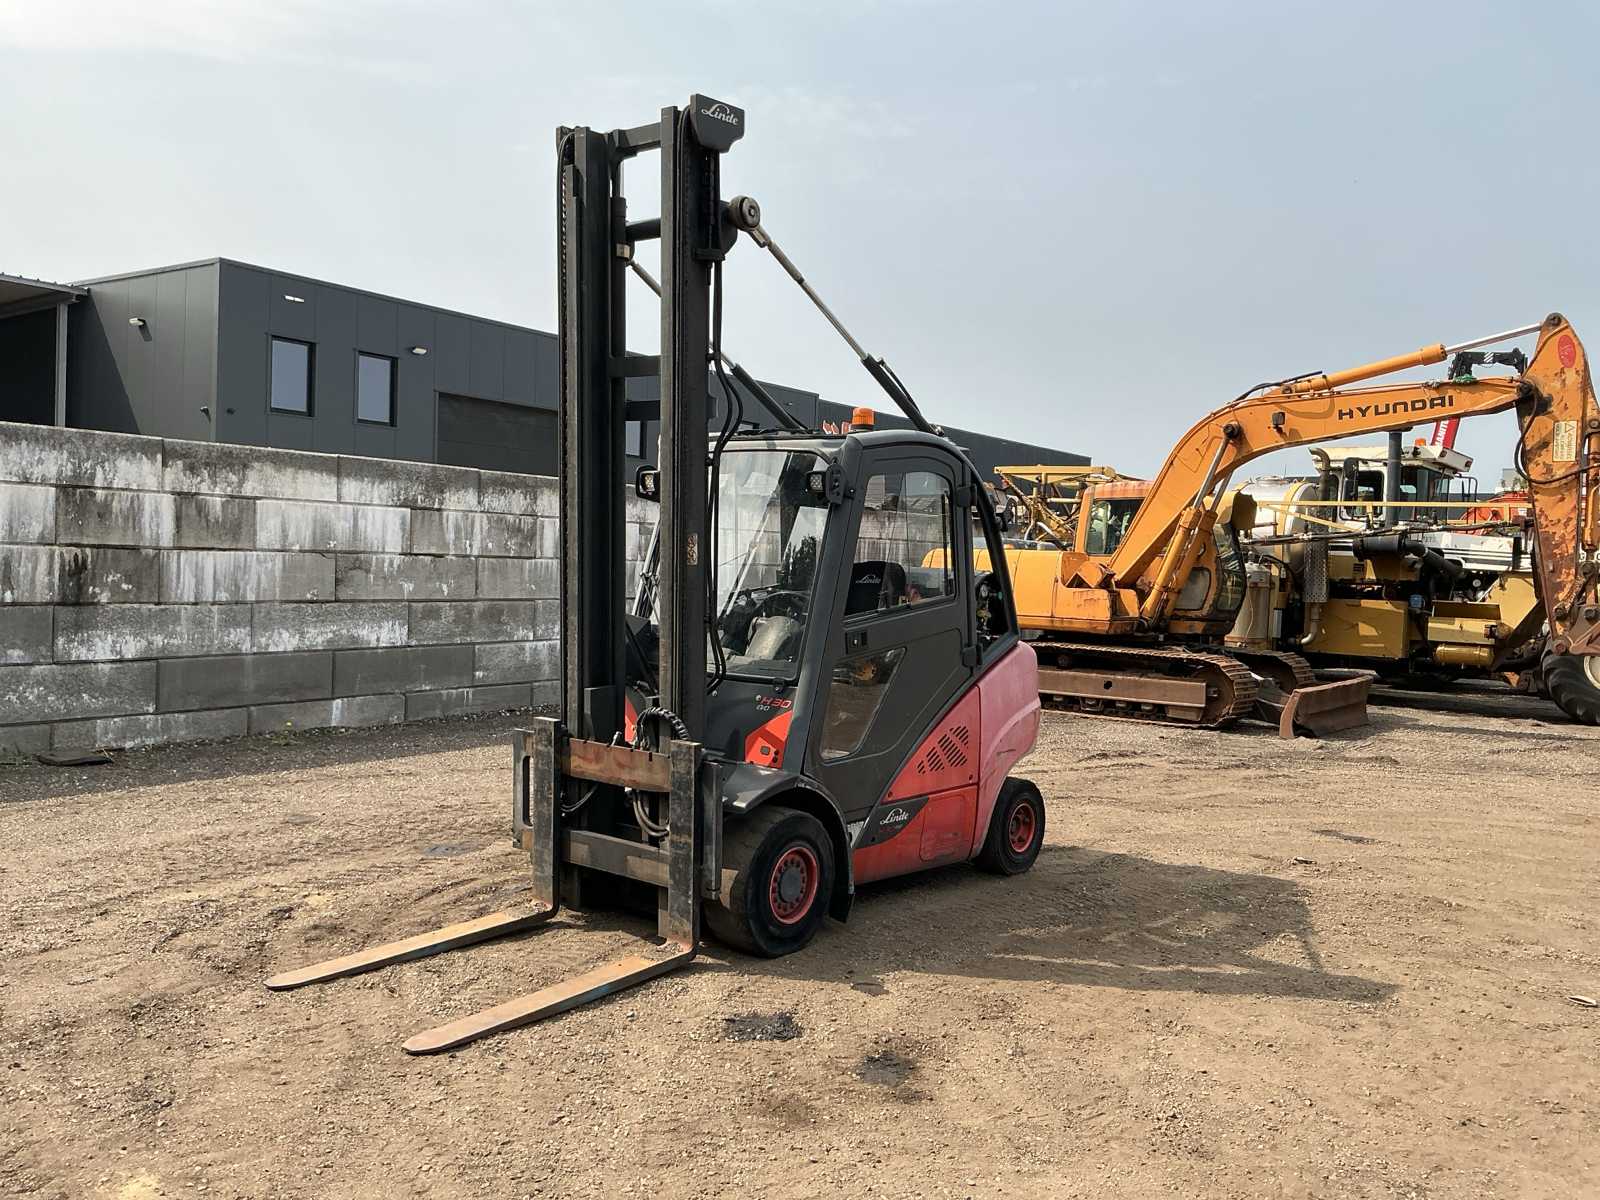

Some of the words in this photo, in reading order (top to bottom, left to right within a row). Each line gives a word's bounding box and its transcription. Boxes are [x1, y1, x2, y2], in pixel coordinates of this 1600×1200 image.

[701, 103, 739, 125] Linde
[1338, 395, 1454, 420] HYUNDAI
[879, 807, 909, 825] Linde
